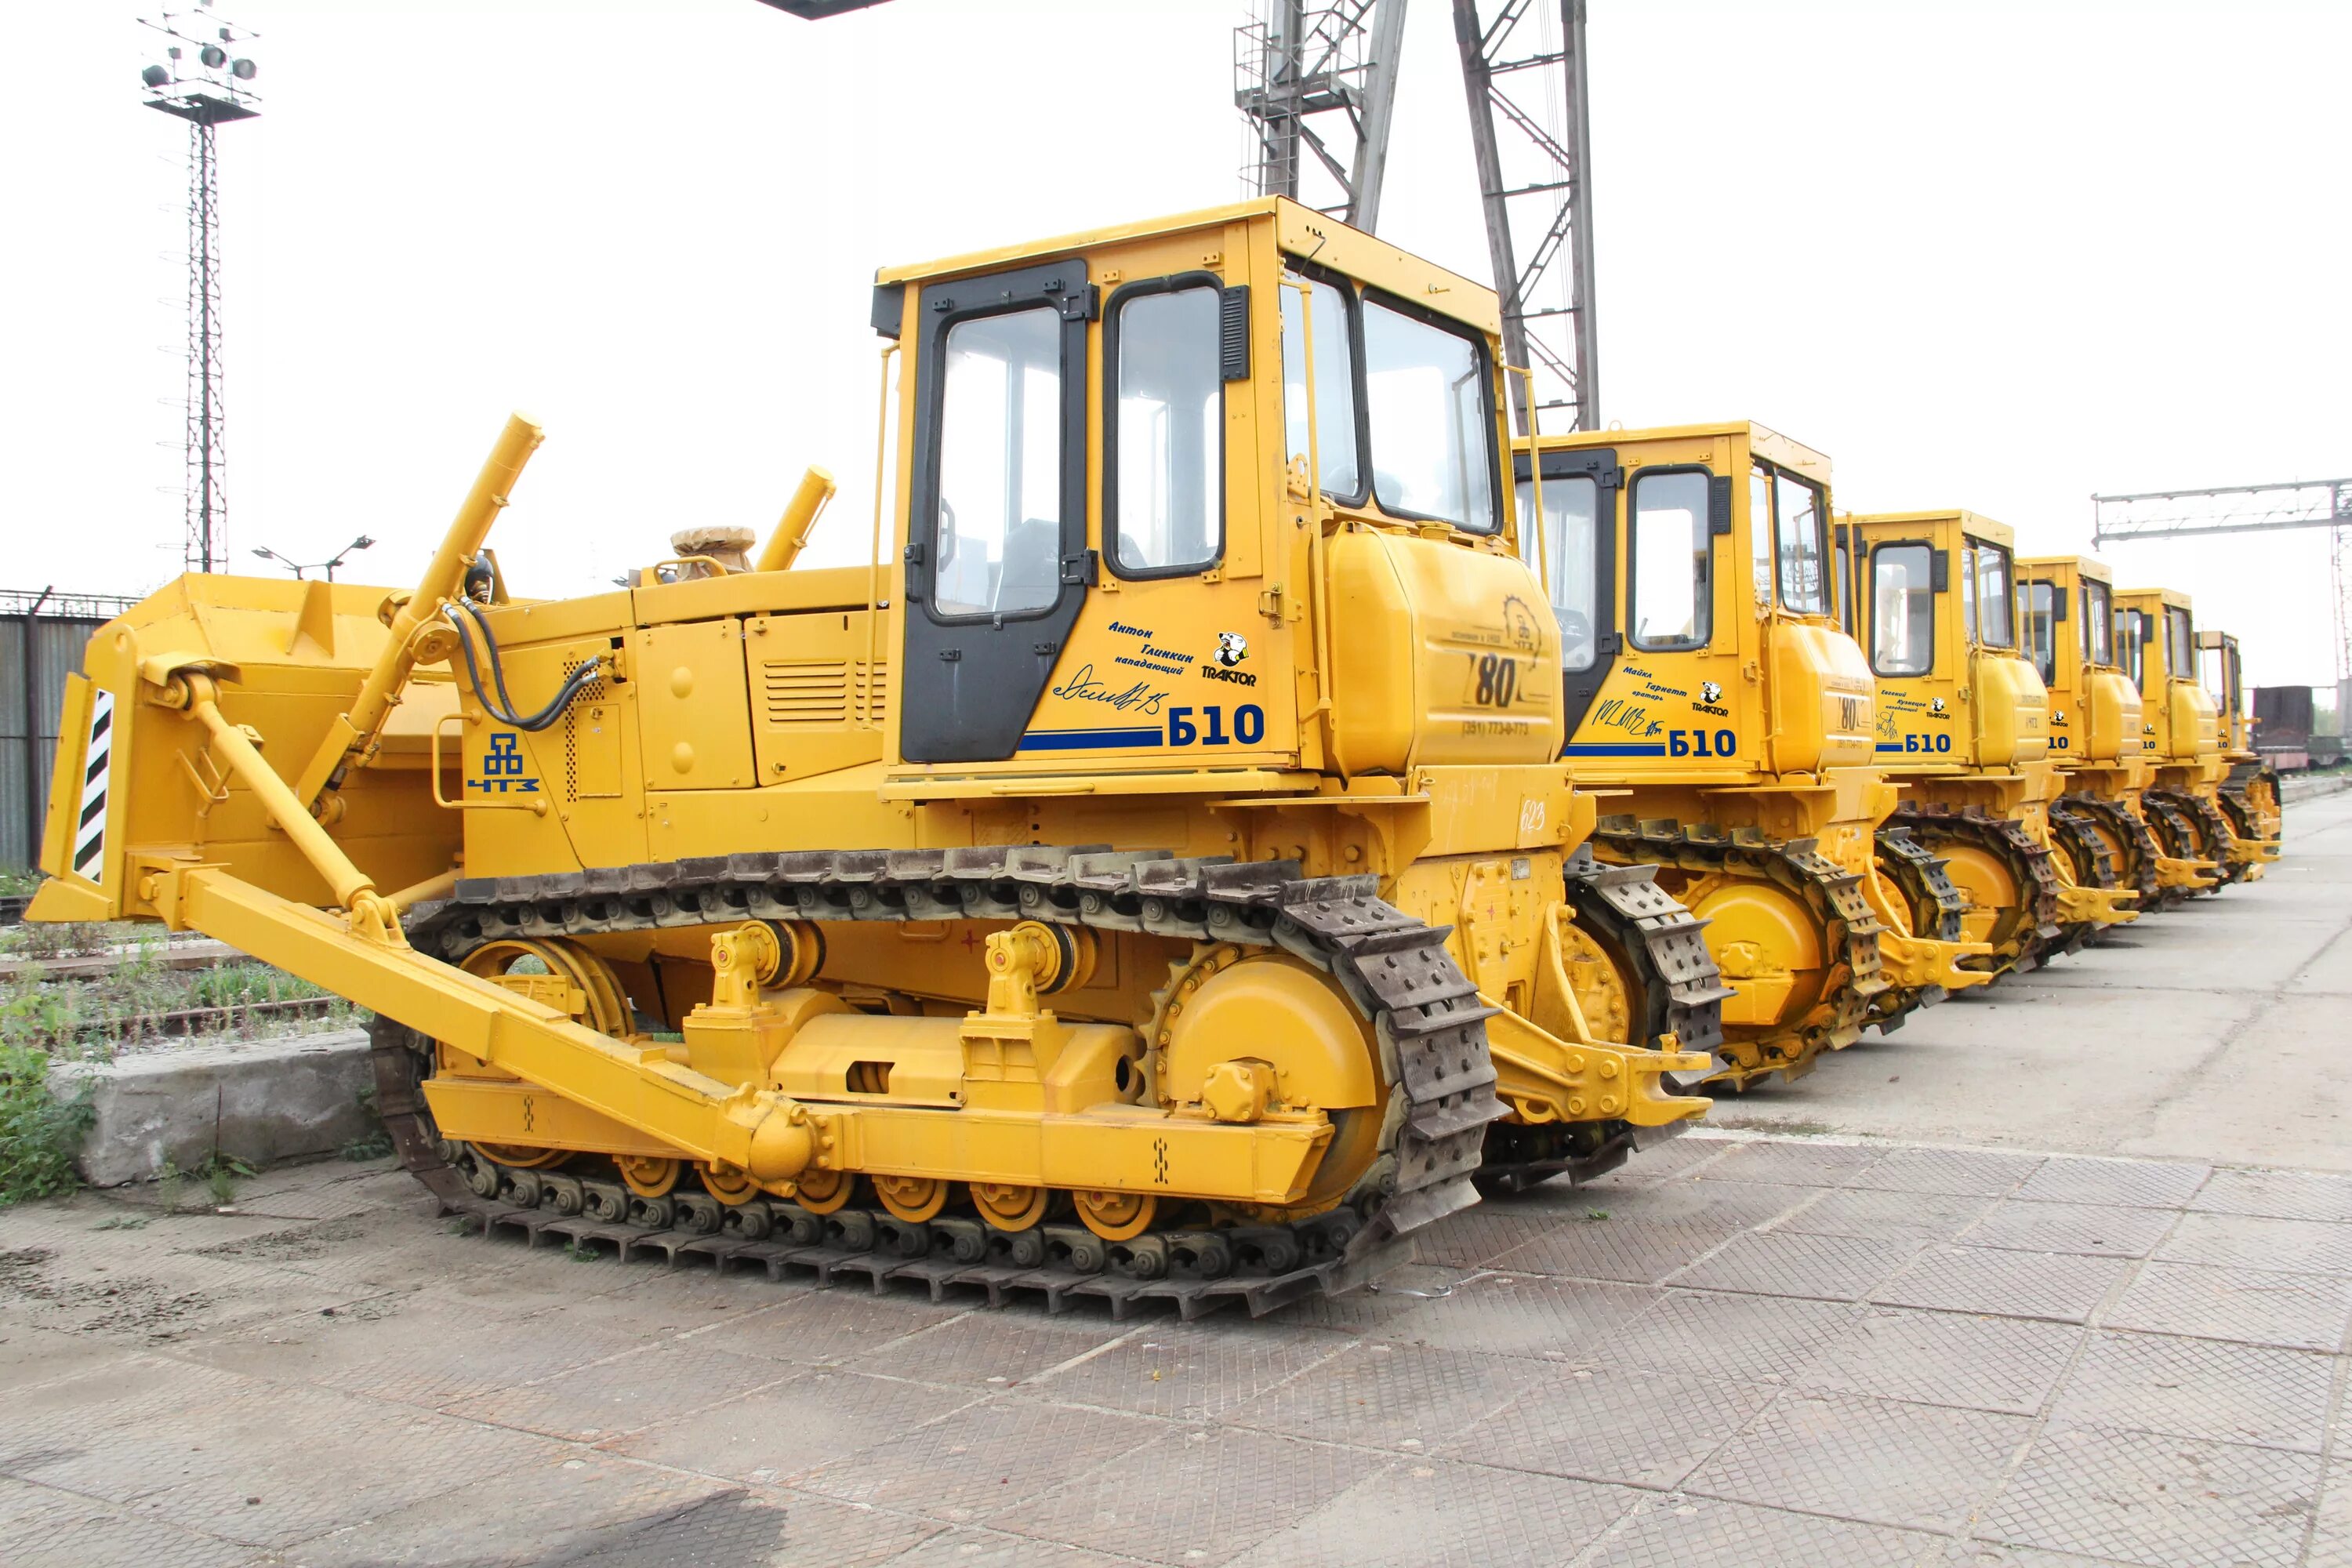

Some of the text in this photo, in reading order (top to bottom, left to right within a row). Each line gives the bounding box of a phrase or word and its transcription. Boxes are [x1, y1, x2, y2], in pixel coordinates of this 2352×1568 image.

[1109, 621, 1153, 638] Антон
[1141, 644, 1194, 663] Глинкин
[1115, 656, 1185, 675] нападающий
[1623, 666, 1652, 679] Майкл
[1202, 665, 1257, 687] TRAKTOR
[1475, 652, 1515, 708] 80
[1632, 690, 1664, 701] вратарь
[1646, 682, 1687, 697] Гарнетт
[1692, 702, 1729, 717] TRAKTOR
[1841, 697, 1857, 731] 80
[1169, 703, 1265, 746] Б10
[1669, 729, 1736, 757] Б10
[1905, 734, 1951, 753] Б10
[467, 779, 539, 793] ЧТЗ
[1520, 800, 1544, 832] 623
